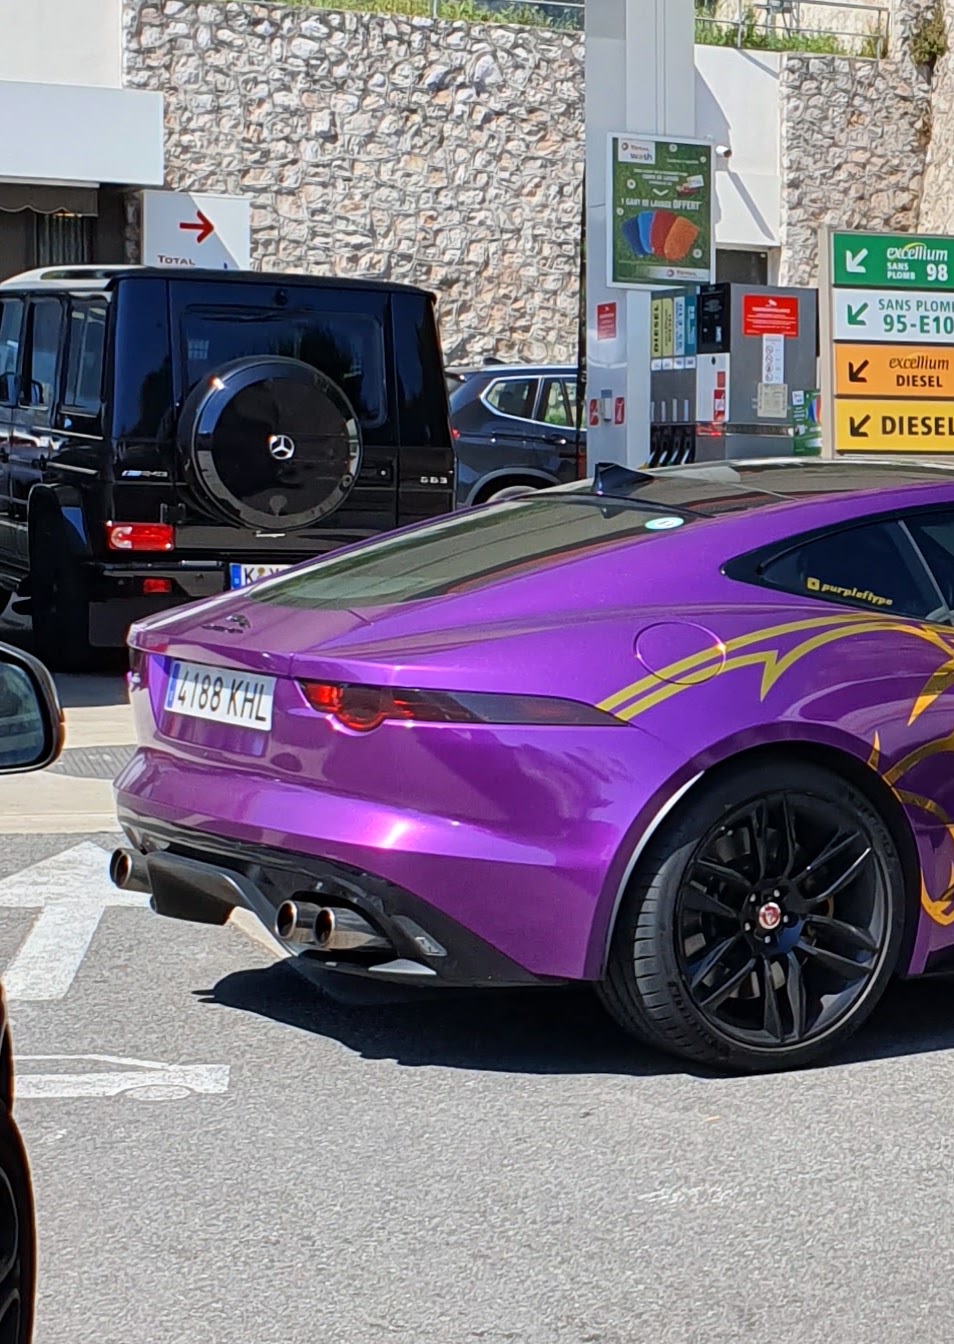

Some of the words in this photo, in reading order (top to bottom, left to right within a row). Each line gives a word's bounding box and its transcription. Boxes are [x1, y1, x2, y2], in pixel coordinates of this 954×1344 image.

[886, 244, 948, 261] excellium
[887, 262, 909, 271] SANS
[926, 263, 949, 281] 98
[887, 271, 916, 280] PLOMB
[878, 298, 911, 312] SANS
[883, 314, 954, 334] 95-E10
[889, 355, 949, 370] excellium
[896, 374, 944, 388] DIESEL
[178, 670, 224, 712] 4188
[227, 678, 267, 722] KHL
